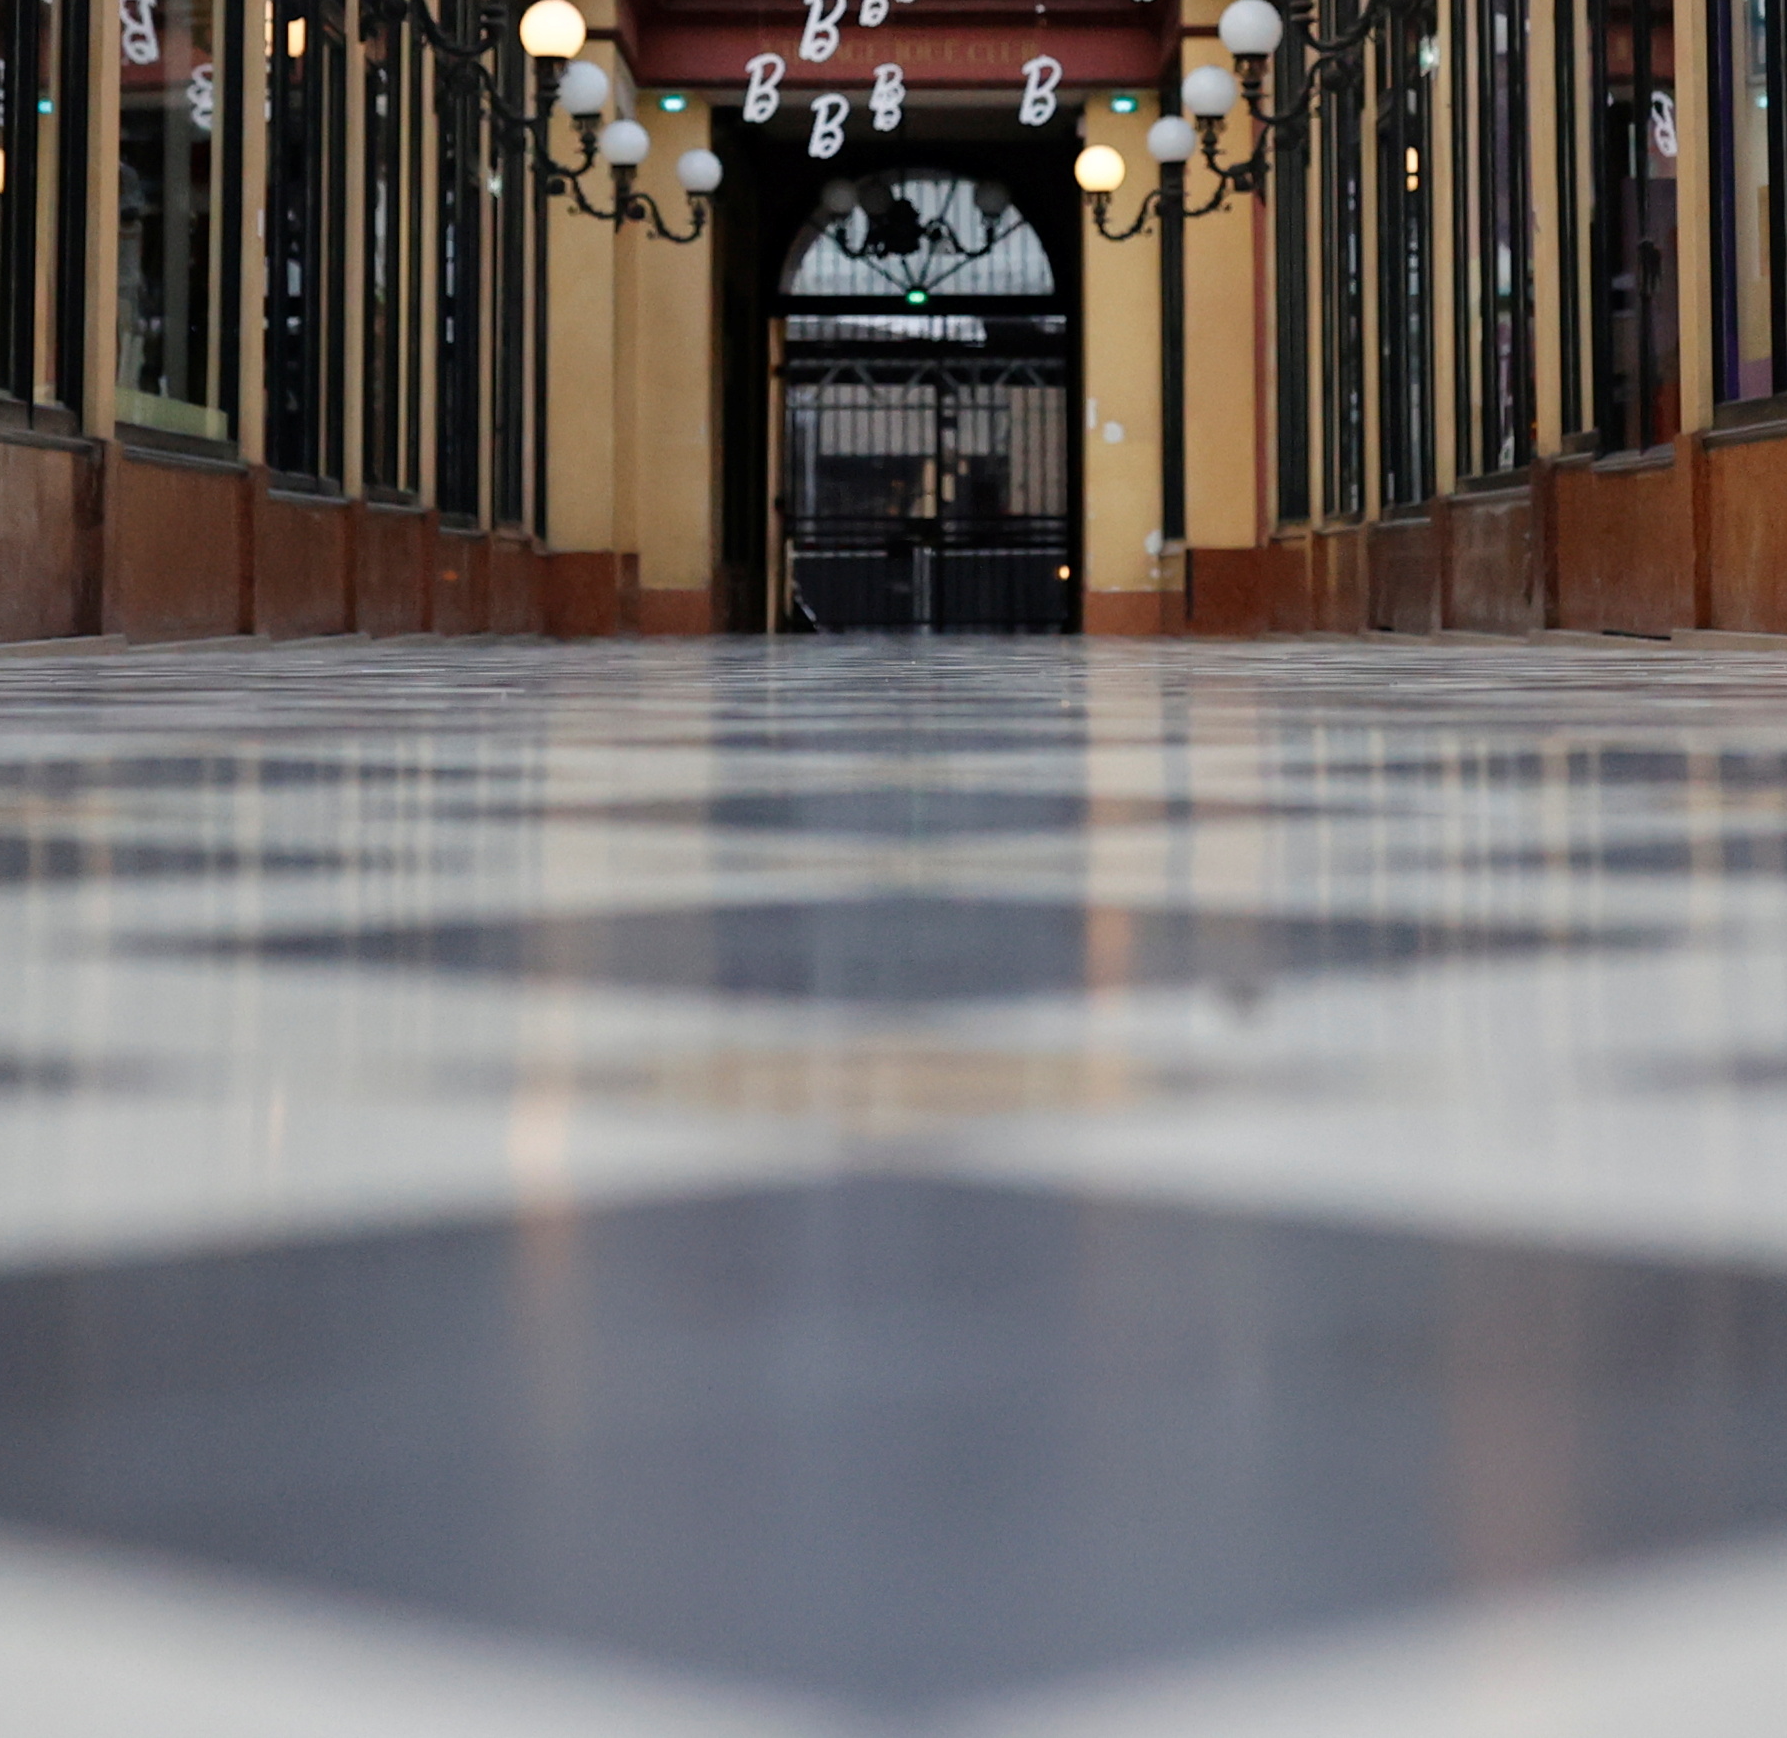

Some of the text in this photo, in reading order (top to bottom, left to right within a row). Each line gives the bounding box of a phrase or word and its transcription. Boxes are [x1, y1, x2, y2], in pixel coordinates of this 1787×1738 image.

[743, 53, 786, 123] B
[1019, 56, 1063, 127] B
[810, 94, 849, 159] B
